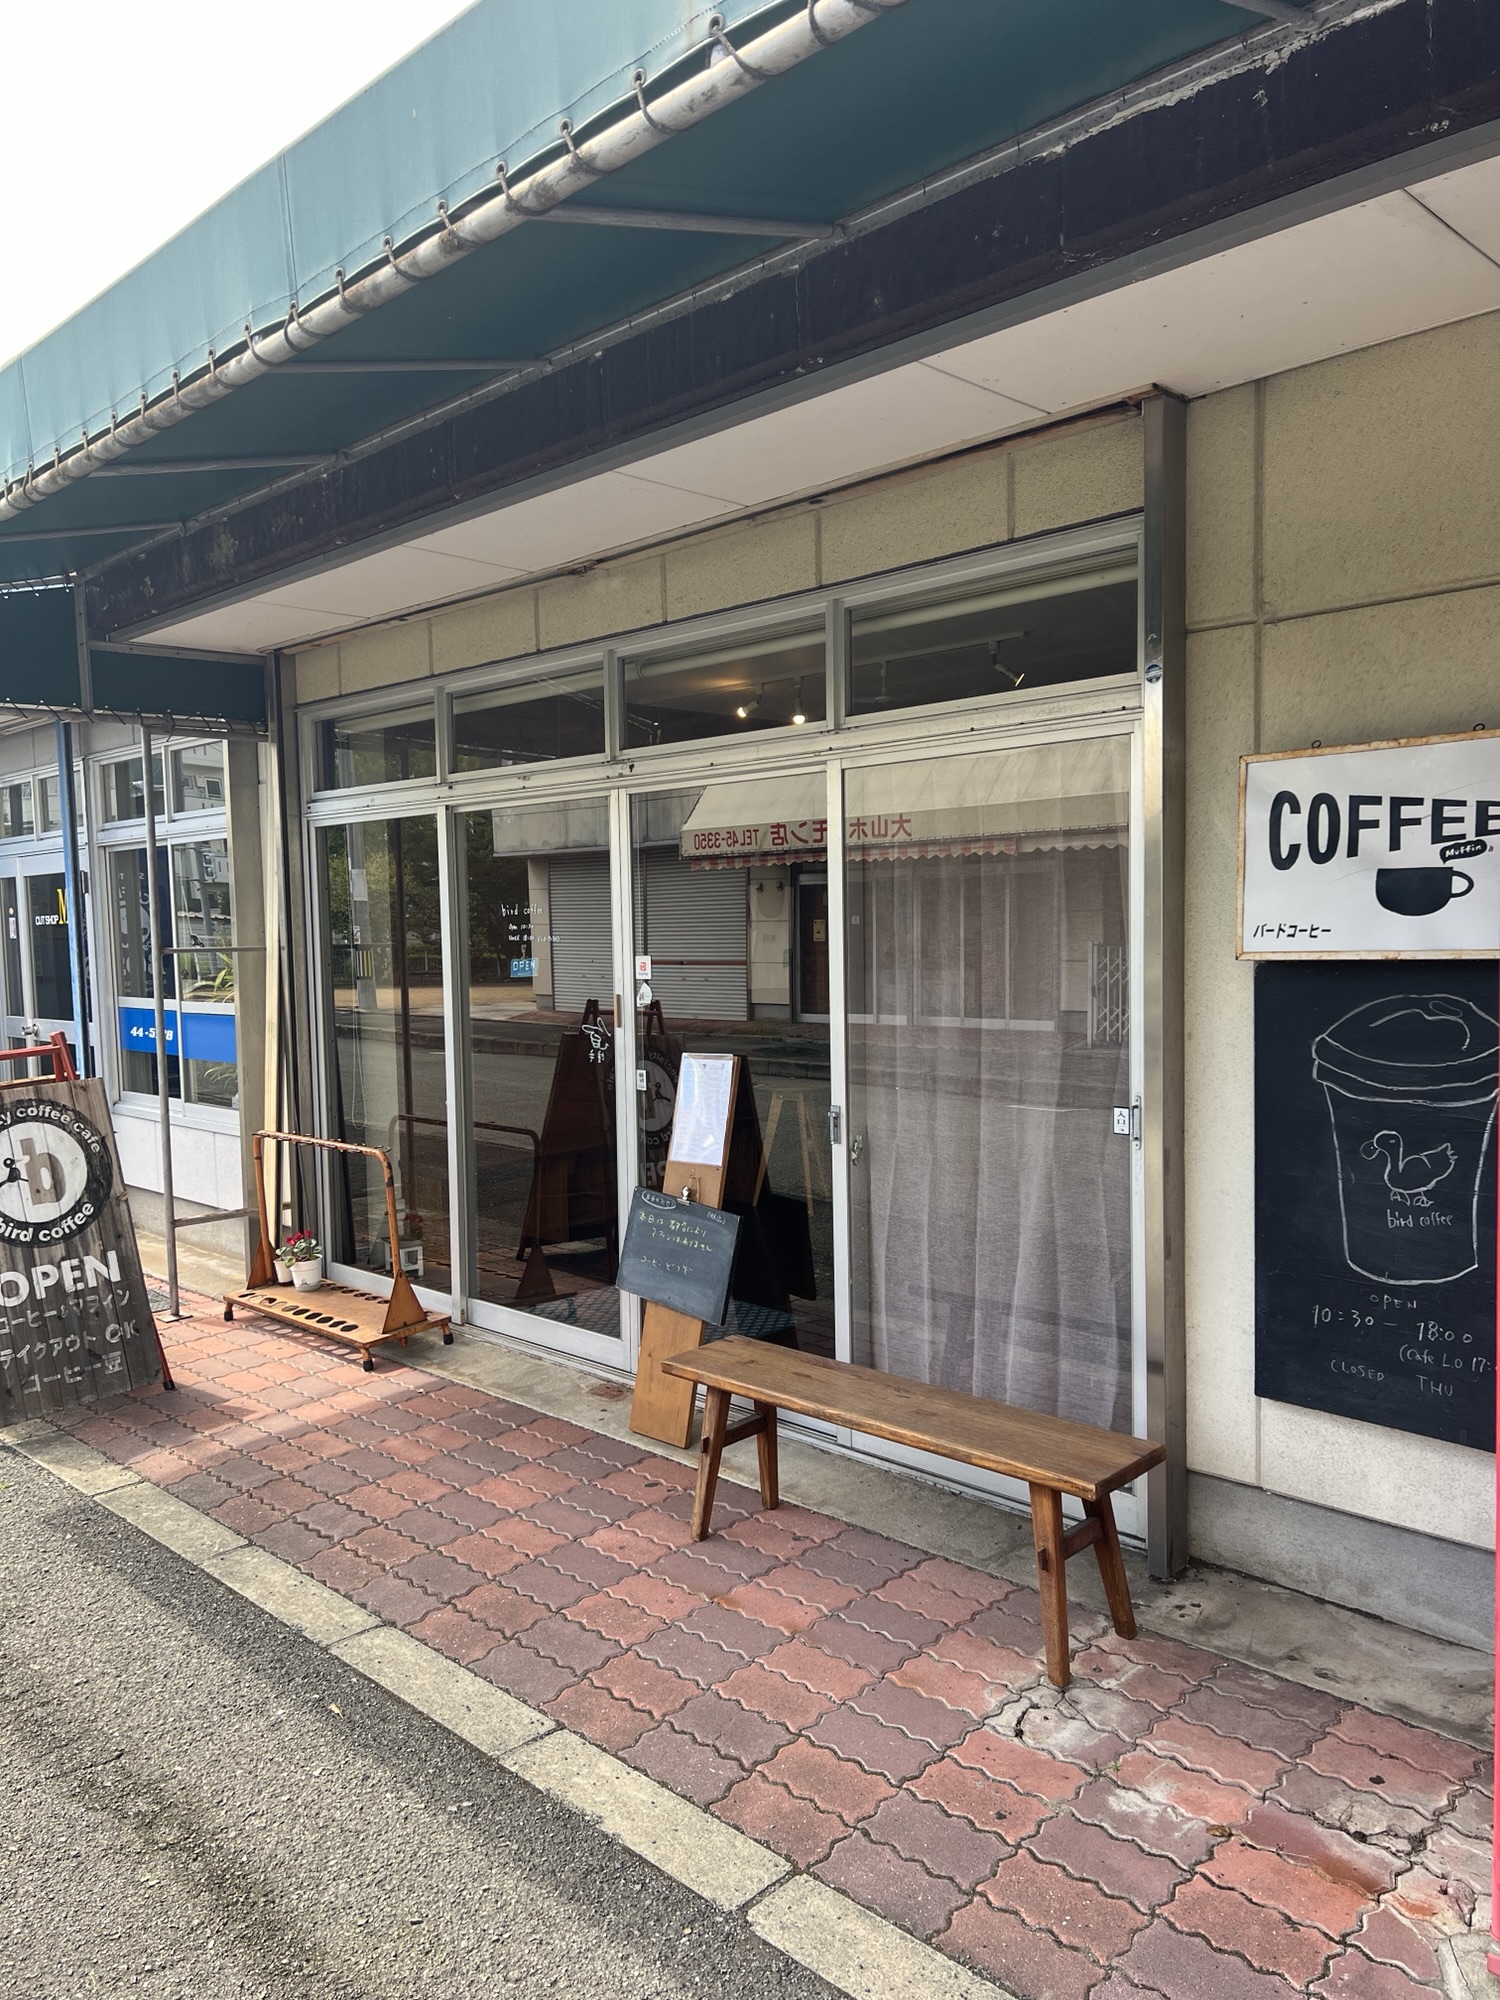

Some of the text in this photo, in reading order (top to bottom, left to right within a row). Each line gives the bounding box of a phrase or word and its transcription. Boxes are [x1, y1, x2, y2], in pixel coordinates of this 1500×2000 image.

[1268, 790, 1500, 871] COFFEE
[1444, 843, 1483, 858] Muffin
[501, 903, 519, 917] bird
[1253, 923, 1332, 939] バードコーヒー
[512, 960, 536, 971] OPEN
[16, 1104, 71, 1125] coffee
[39, 1203, 94, 1242] coffee
[1387, 1209, 1453, 1229] bird coffee
[0, 1250, 121, 1308] OPEN
[1370, 1294, 1418, 1310] OPEN
[1312, 1304, 1375, 1328] 10:30
[1417, 1321, 1473, 1344] 18:00
[0, 1318, 140, 1369] テイクアウト OK
[1471, 1356, 1497, 1374] 17:
[1329, 1359, 1454, 1397] CLOSED THU
